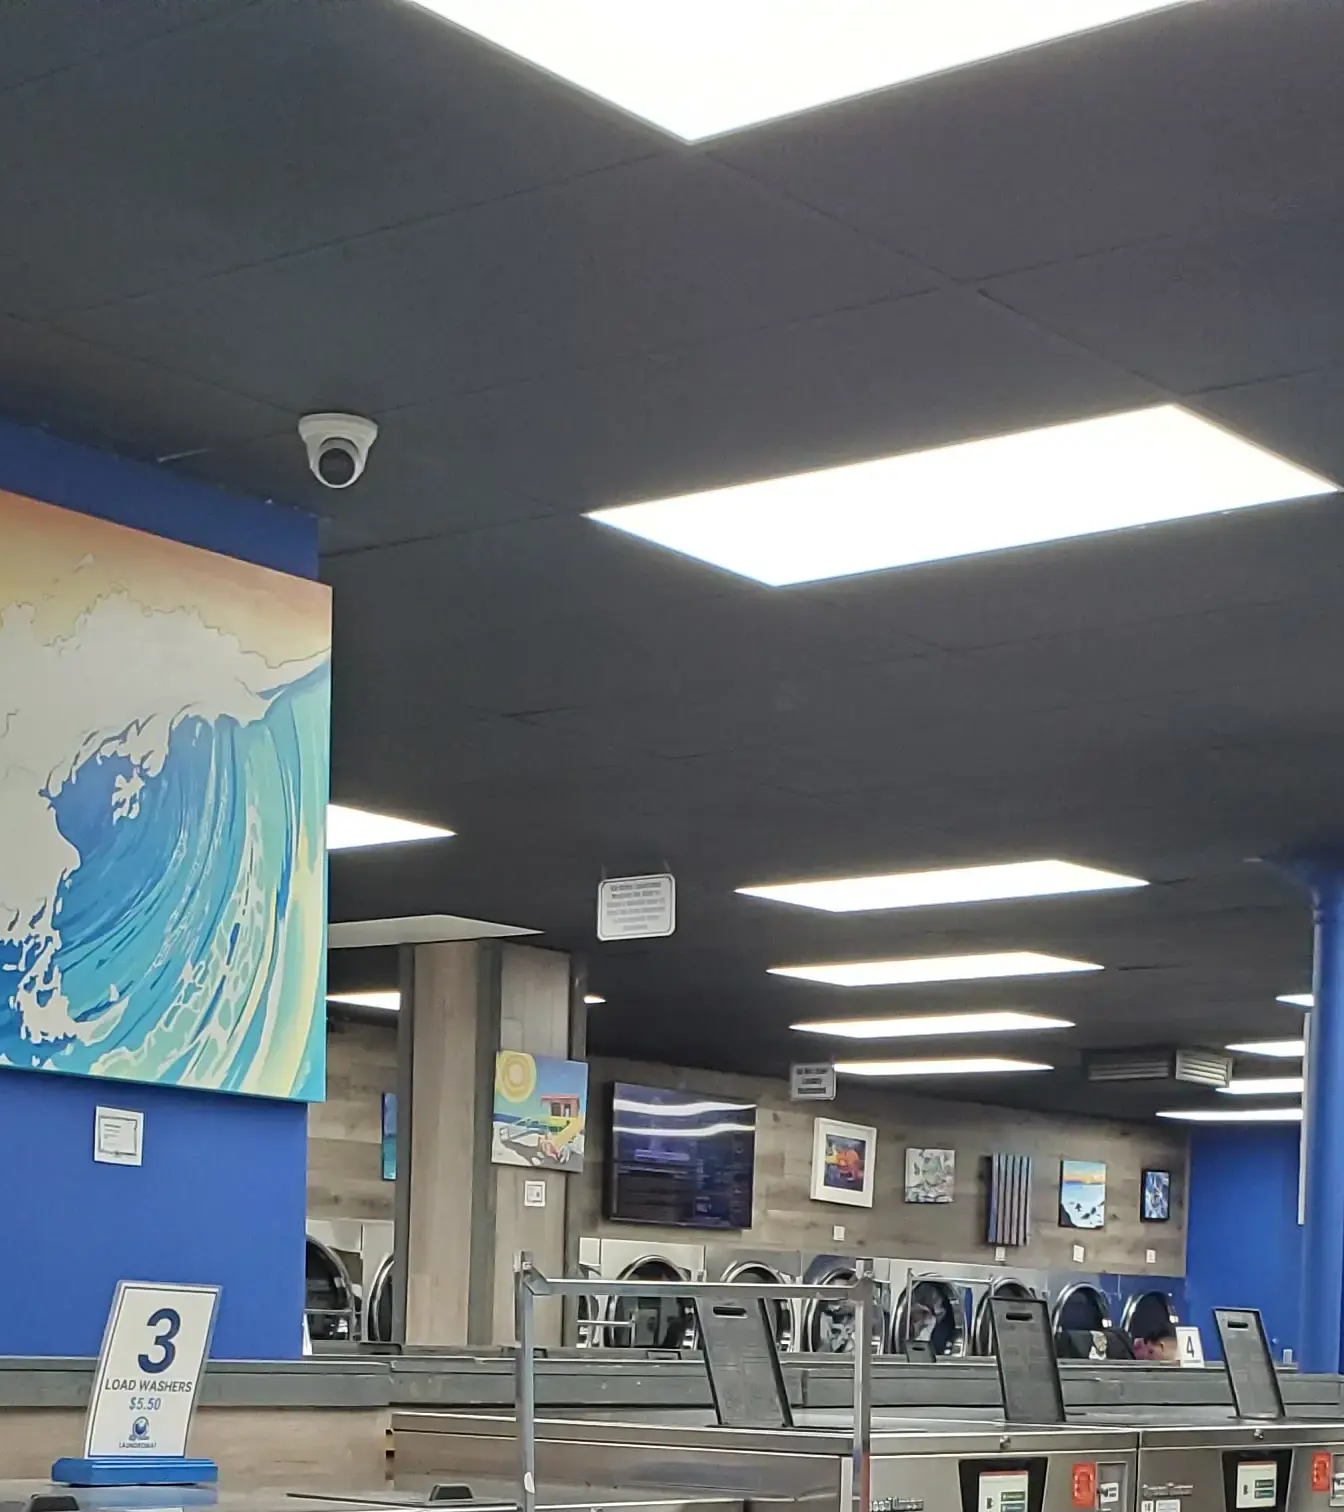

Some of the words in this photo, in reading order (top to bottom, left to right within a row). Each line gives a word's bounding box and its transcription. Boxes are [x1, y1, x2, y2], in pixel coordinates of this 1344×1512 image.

[137, 1307, 181, 1374] 3
[1186, 1335, 1195, 1358] 4
[105, 1379, 136, 1391] LOAD
[139, 1380, 193, 1393] WASHERS
[128, 1396, 162, 1411] $5.50
